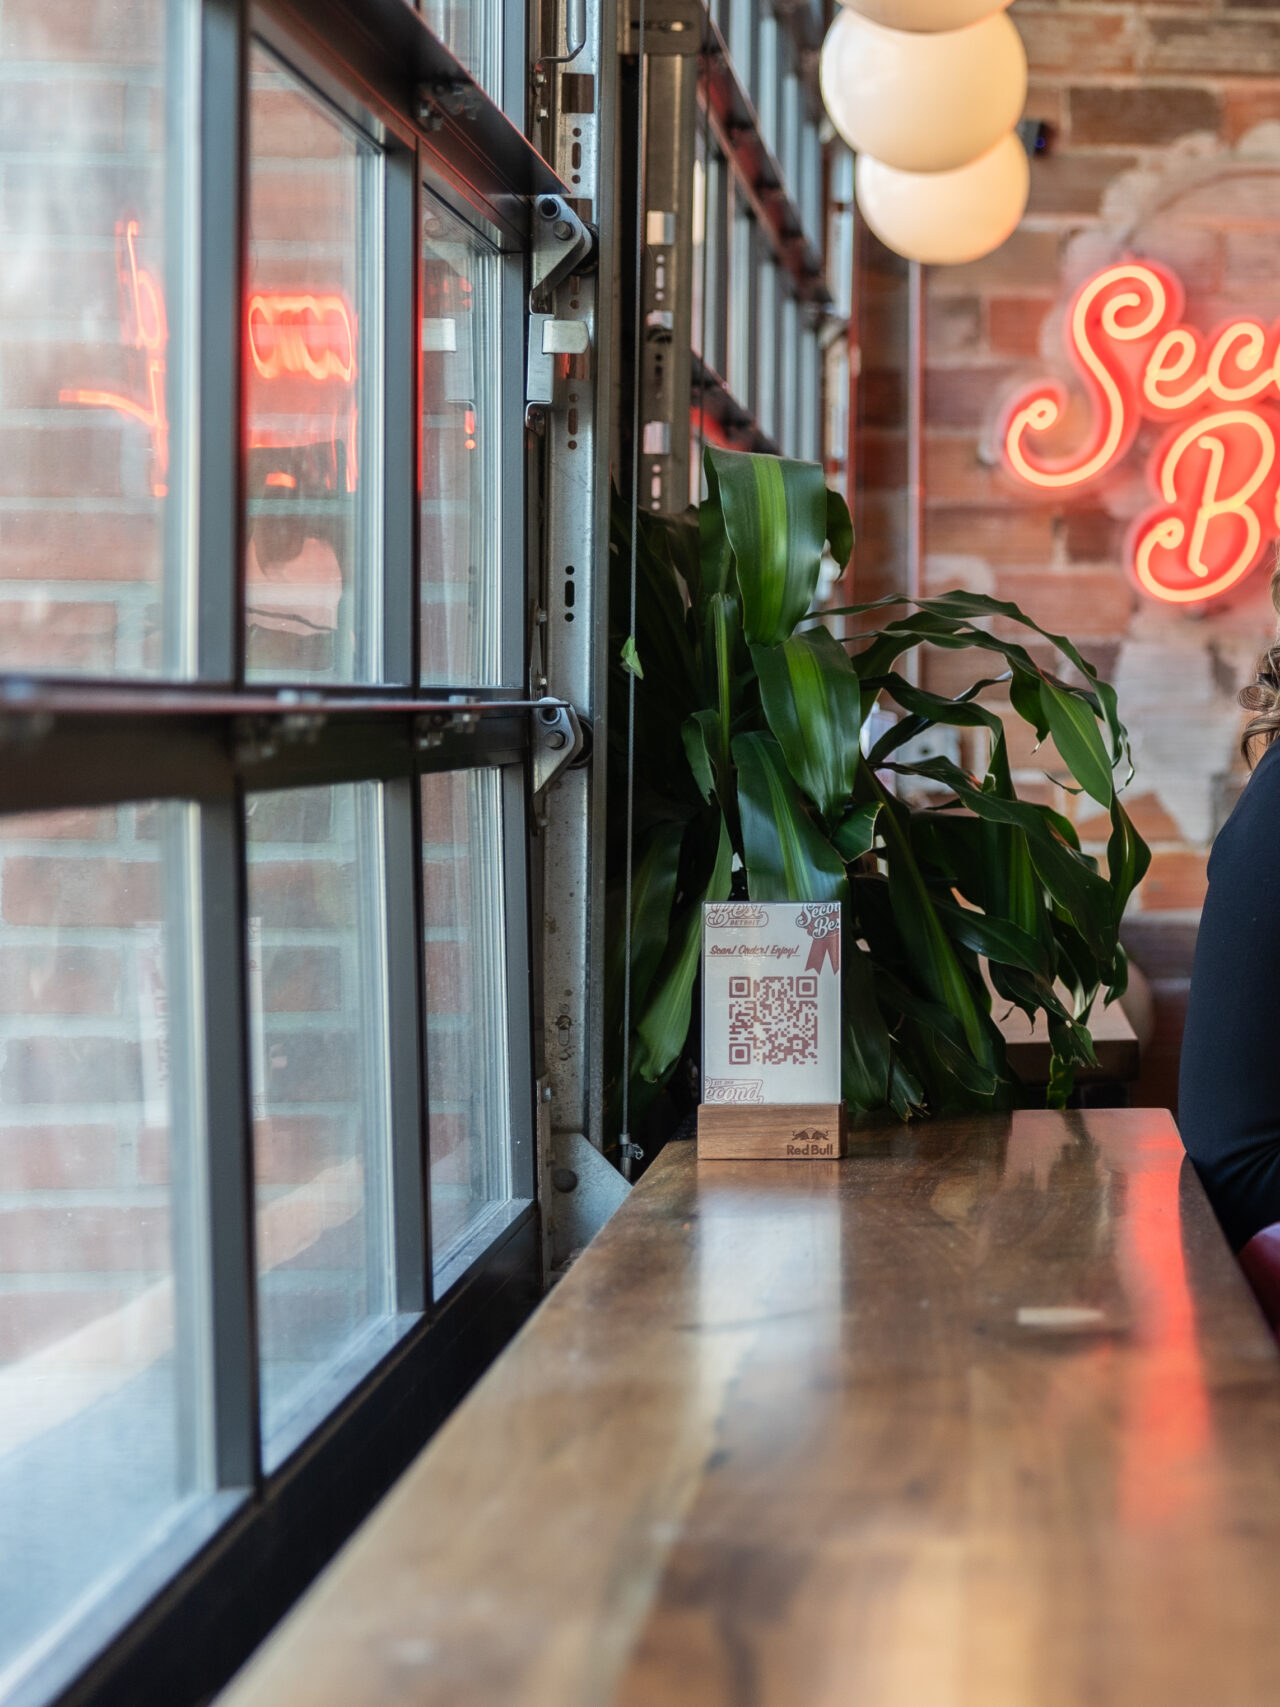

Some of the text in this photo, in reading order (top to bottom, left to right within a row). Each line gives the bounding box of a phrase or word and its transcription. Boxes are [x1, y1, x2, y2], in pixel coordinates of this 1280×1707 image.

[795, 903, 841, 928] Seco
[812, 915, 841, 938] Bes
[709, 944, 800, 959] Scan! Order! Enjoy!
[787, 1143, 834, 1156] Red Bull
